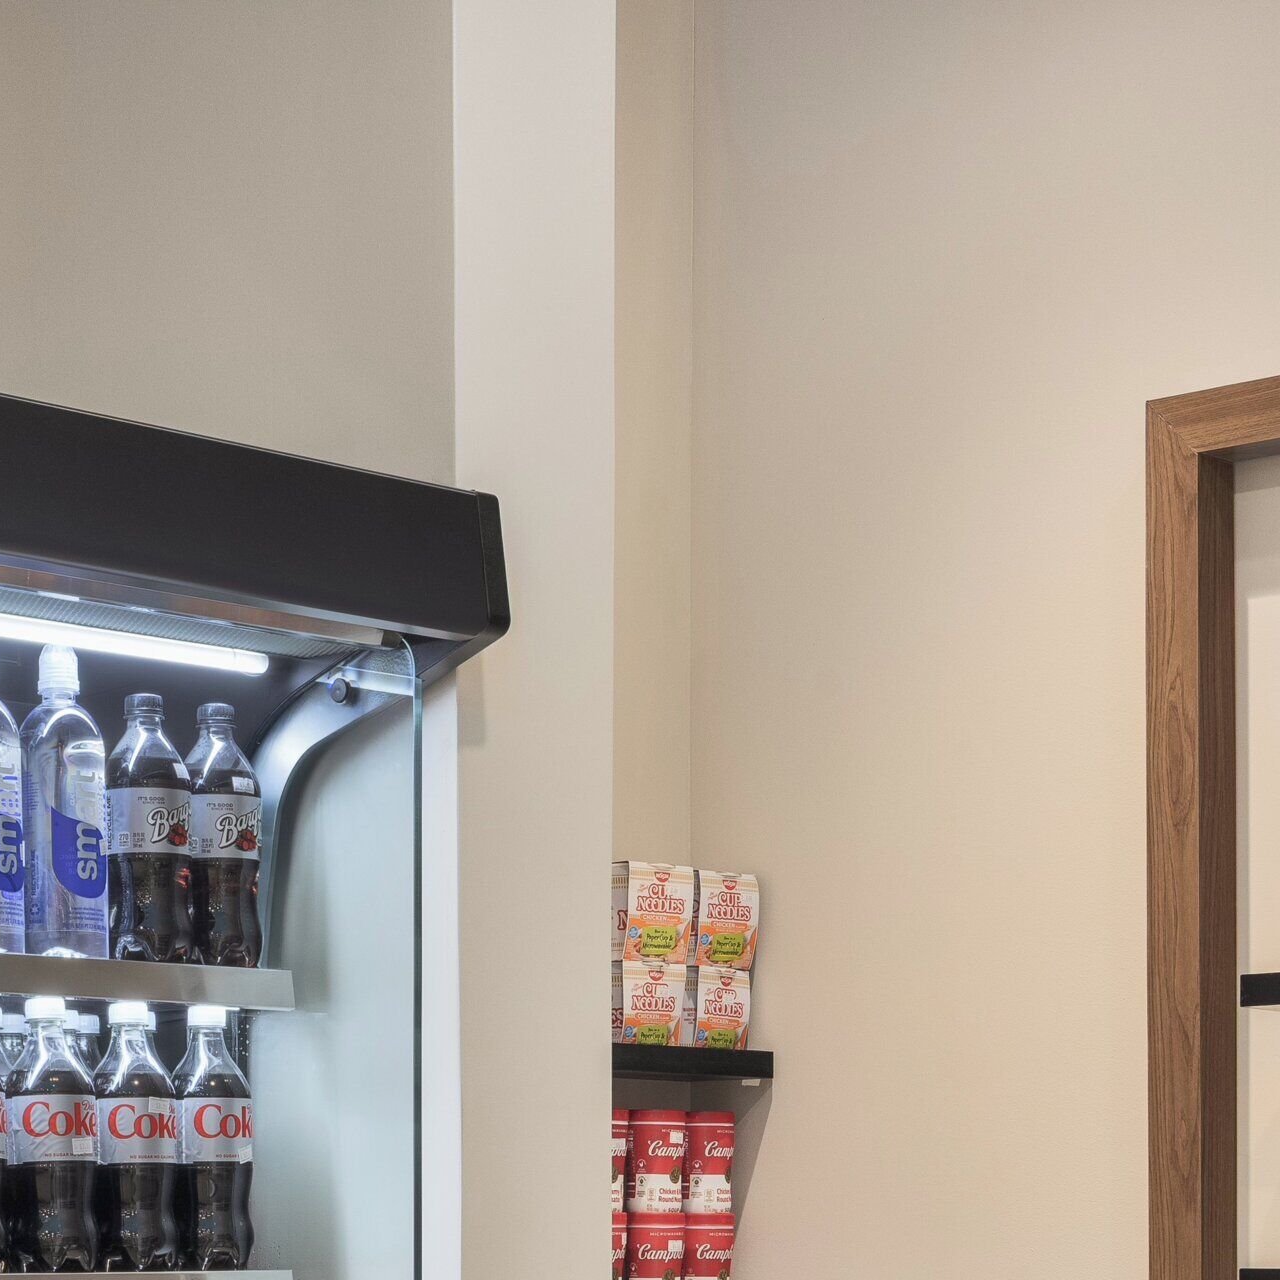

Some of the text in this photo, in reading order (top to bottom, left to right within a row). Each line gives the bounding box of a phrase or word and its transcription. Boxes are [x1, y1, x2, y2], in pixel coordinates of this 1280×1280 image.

[75, 765, 98, 880] smart
[637, 896, 684, 914] NOODLES
[718, 891, 741, 905] CUP
[707, 903, 751, 921] NOODLES
[705, 1000, 743, 1018] NOODLES
